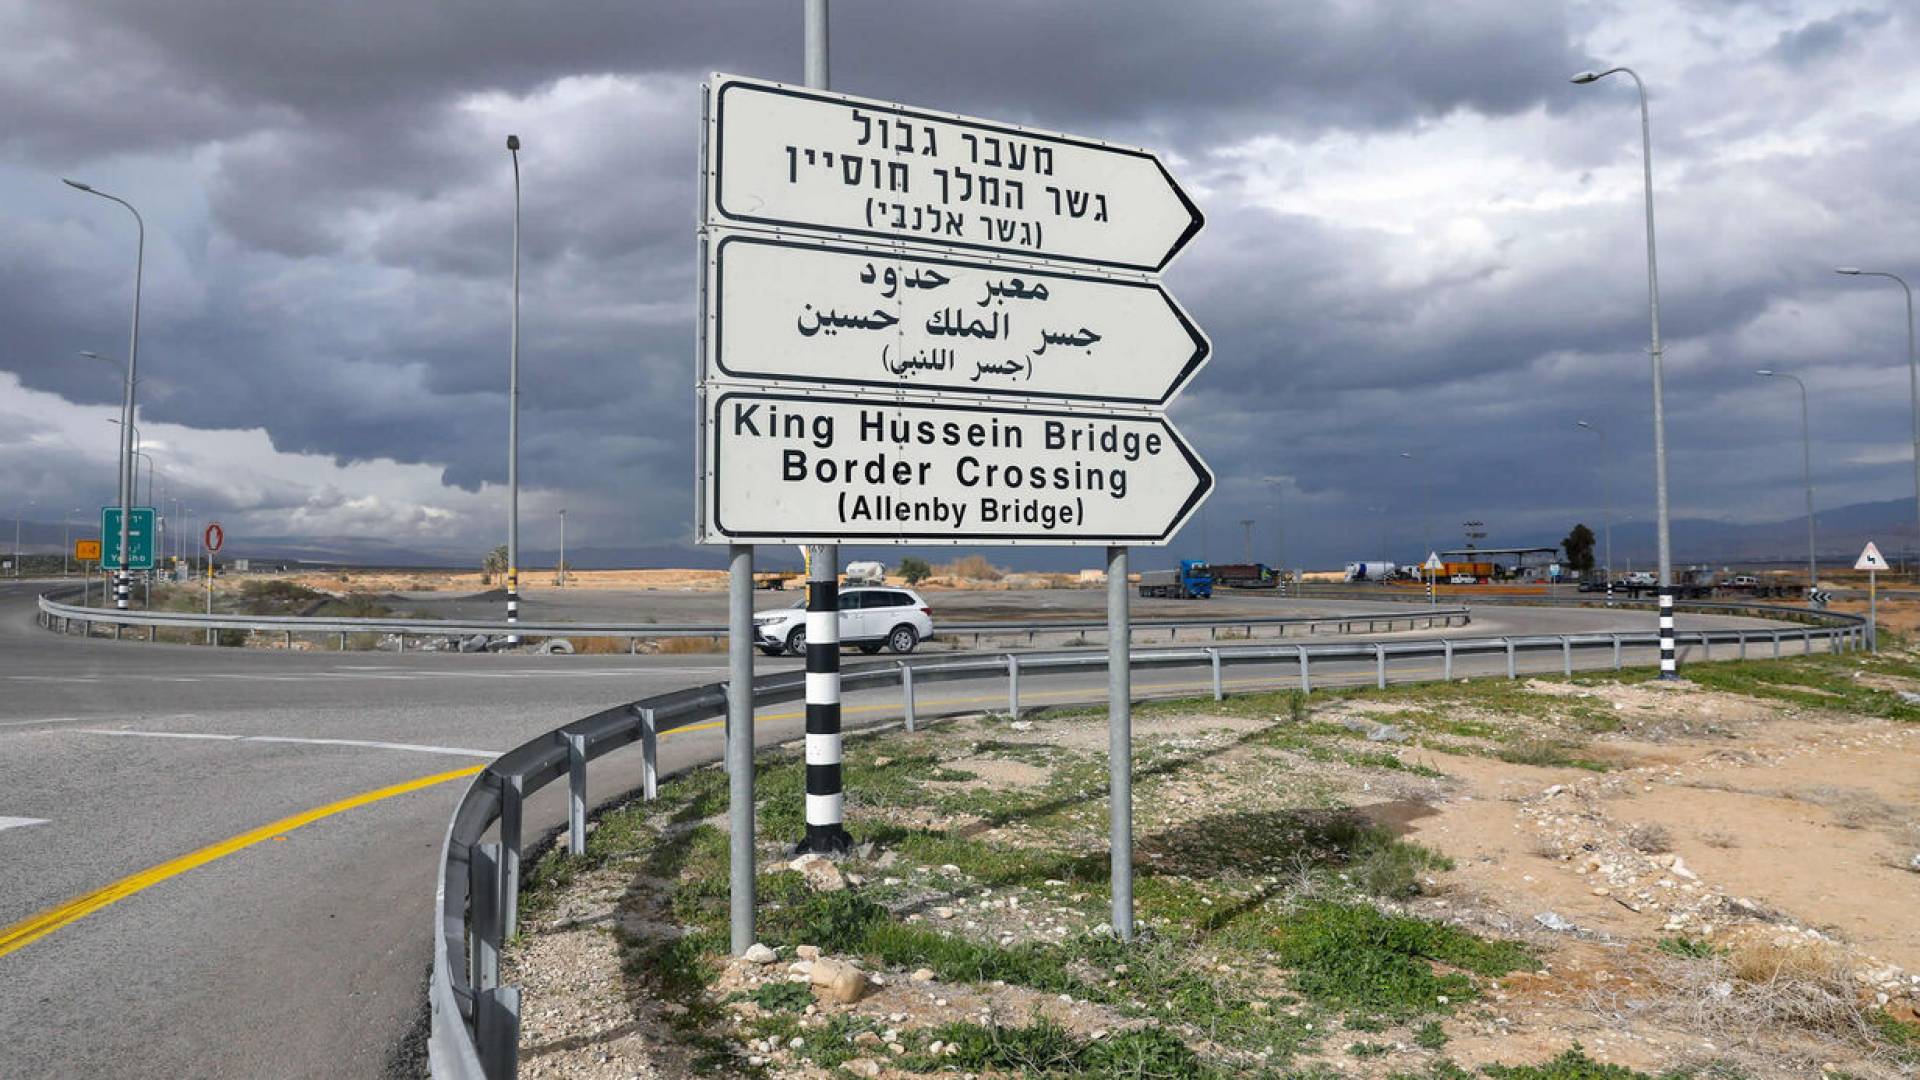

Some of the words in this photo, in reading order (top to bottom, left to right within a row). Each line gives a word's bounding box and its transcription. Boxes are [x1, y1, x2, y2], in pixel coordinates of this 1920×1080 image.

[852, 108, 938, 157] גבול
[785, 145, 910, 194] חוסיין
[961, 133, 1054, 177] מעבר
[933, 166, 1025, 210] המלך
[1045, 186, 1109, 223] גשר
[865, 197, 964, 237] אלנבי)
[979, 216, 1043, 250] (גשר
[859, 262, 951, 299] حدود
[976, 278, 1050, 308] معبر
[797, 303, 900, 338] حسين
[925, 306, 1010, 340] الملك
[1032, 325, 1103, 356] جسر
[970, 355, 1033, 382] (جسر
[734, 403, 834, 450] King
[860, 410, 1023, 449] Hussein
[1045, 420, 1162, 462] Bridge
[782, 448, 933, 487] Border
[956, 455, 1128, 501] Crossing
[838, 491, 968, 530] (Allenby
[981, 496, 1085, 532] Bridge)
